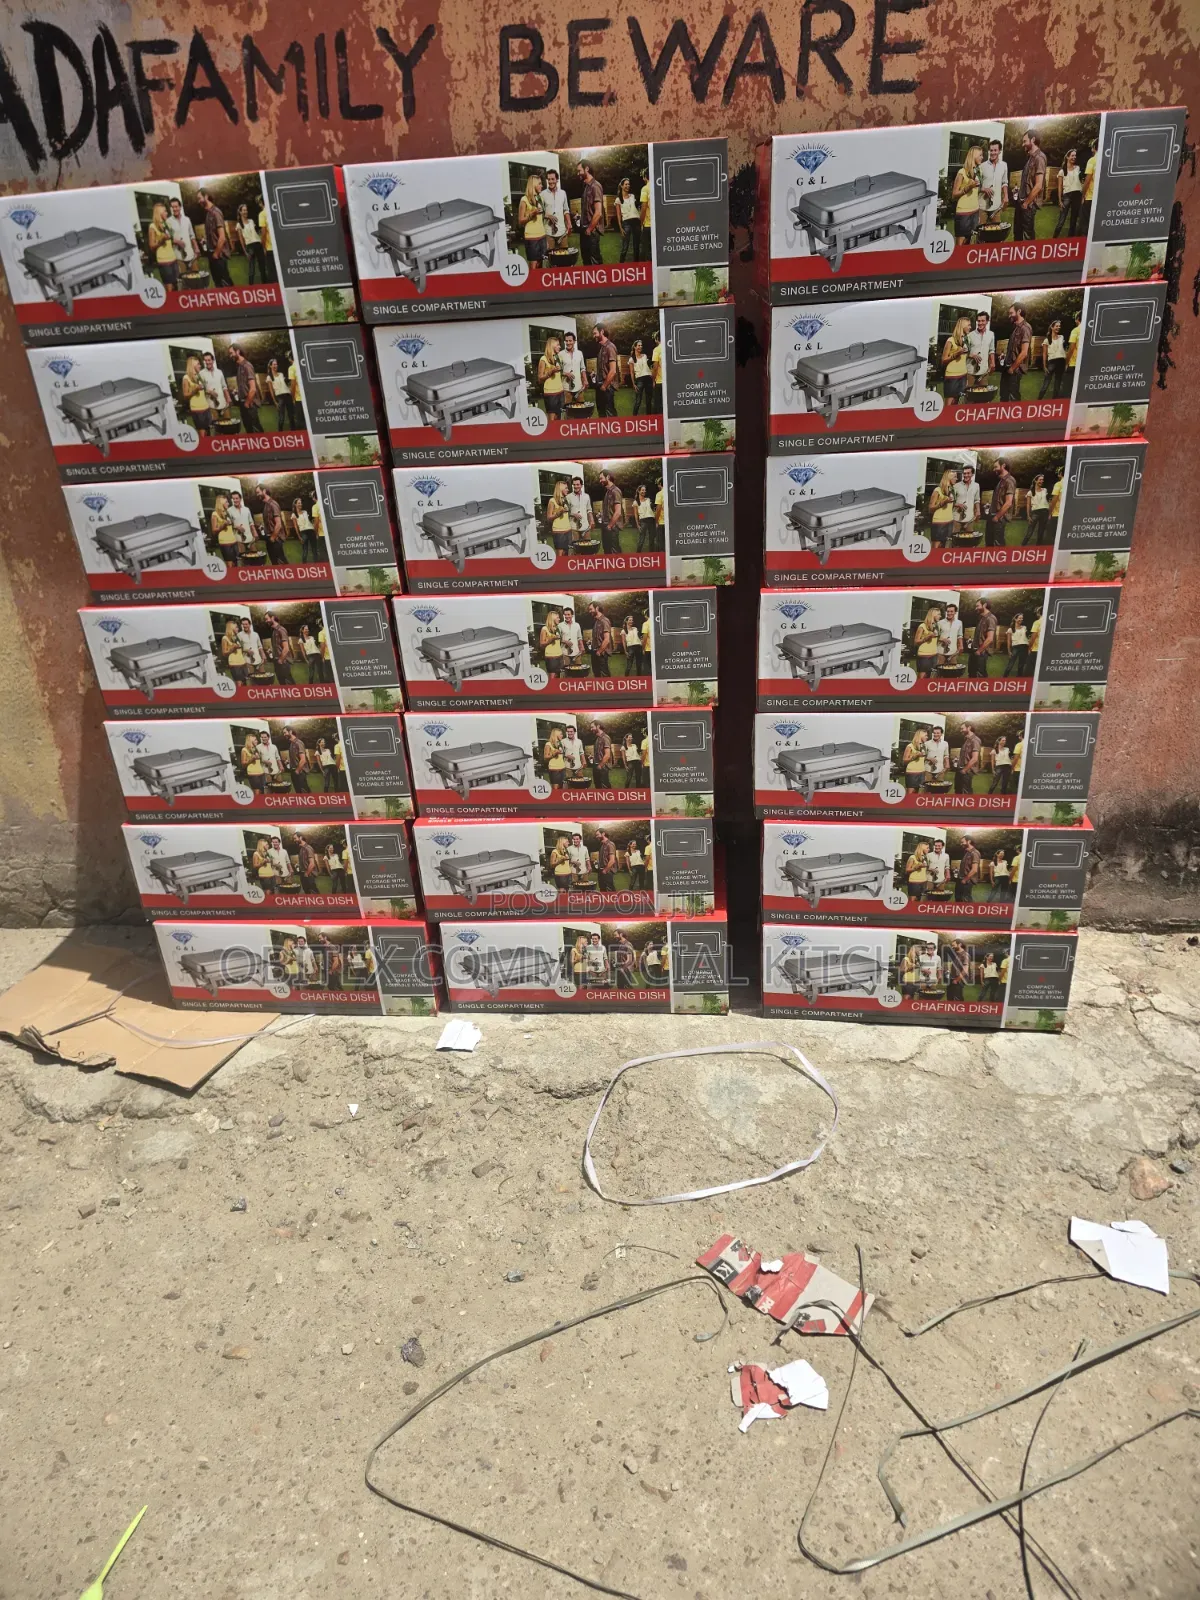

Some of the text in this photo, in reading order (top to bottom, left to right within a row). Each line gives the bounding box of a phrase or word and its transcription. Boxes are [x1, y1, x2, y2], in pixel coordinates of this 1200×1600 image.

[499, 0, 929, 112] BEWARE
[796, 175, 827, 187] G & L
[371, 202, 400, 212] G & L
[1117, 198, 1154, 208] COMPACT
[1106, 207, 1162, 218] STORAGE WITH
[1101, 216, 1165, 227] FOLDABLE STAND
[675, 225, 710, 234] COMPACT
[16, 231, 42, 241] G & L
[666, 233, 719, 244] STORAGE WITH
[663, 242, 723, 252] FOLDABLE STAND
[929, 239, 950, 254] 12L
[296, 248, 328, 257] COMPACT
[966, 242, 1080, 264] CHAFING DISH
[289, 255, 339, 266] STORAGE WITH
[287, 263, 344, 274] FOLDABLE STAND
[505, 263, 525, 277] 12L
[541, 267, 646, 287] CHAFING DISH
[143, 286, 163, 299] 12L
[780, 279, 904, 296] SINGLE COMPARTMENT
[178, 288, 277, 309] CHAFING DISH
[373, 300, 487, 315] SINGLE COMPARTMENT
[29, 322, 132, 337] SINGLE COMPARTMENT
[793, 342, 823, 352] G & L
[401, 361, 408, 369] G
[421, 360, 428, 368] L
[1100, 364, 1136, 373] COMPACT
[1089, 372, 1144, 382] STORAGE WITH
[1084, 380, 1146, 390] FOLDABLE STAND
[919, 400, 940, 412] 12L
[954, 403, 1064, 422] CHAFING DISH
[525, 415, 545, 427] 12L
[559, 419, 658, 437] CHAFING DISH
[177, 432, 197, 443] 12L
[211, 434, 305, 452] CHAFING DISH
[778, 434, 895, 448] SINGLE COMPARTMENT
[403, 447, 509, 460] SINGLE COMPARTMENT
[66, 463, 166, 476] SINGLE COMPARTMENT
[908, 543, 927, 554] 12L
[534, 551, 553, 562] 12L
[942, 549, 1047, 564] CHAFING DISH
[206, 562, 224, 573] 12L
[567, 556, 661, 571] CHAFING DISH
[238, 566, 327, 581] CHAFING DISH
[774, 572, 885, 581] SINGLE COMPARTMENT
[418, 579, 519, 589] SINGLE COMPARTMENT
[100, 590, 195, 601] SINGLE COMPARTMENT
[528, 674, 546, 683] 12L
[895, 673, 913, 683] 12L
[216, 682, 234, 691] 12L
[559, 679, 647, 692] CHAFING DISH
[927, 680, 1027, 692] CHAFING DISH
[247, 686, 333, 699] CHAFING DISH
[144, 706, 206, 715] COMPARTMENT
[235, 790, 252, 799] 12L
[532, 785, 549, 794] 12L
[884, 788, 902, 798] 12L
[264, 795, 347, 806] CHAFING DISH
[561, 791, 646, 802] CHAFING DISH
[915, 796, 1011, 808] CHAFING DISH
[165, 812, 224, 820] COMPARTMENT
[796, 809, 865, 817] COMPARTMENT
[246, 890, 263, 898] 12L
[567, 893, 650, 904] CHAFING DISH
[274, 896, 354, 905] CHAFING DISH
[888, 896, 905, 905] 12L
[917, 903, 1009, 916] CHAFING DISH
[803, 914, 868, 922] COMPARTMENT
[273, 986, 288, 994] 12L
[558, 985, 574, 993] 12L
[300, 992, 376, 1002] CHAFING DISH
[586, 991, 666, 1000] CHAFING DISH
[882, 994, 899, 1003] 12L
[911, 1002, 998, 1014] CHAFING DISH
[801, 1010, 864, 1018] COMPARTMENT
